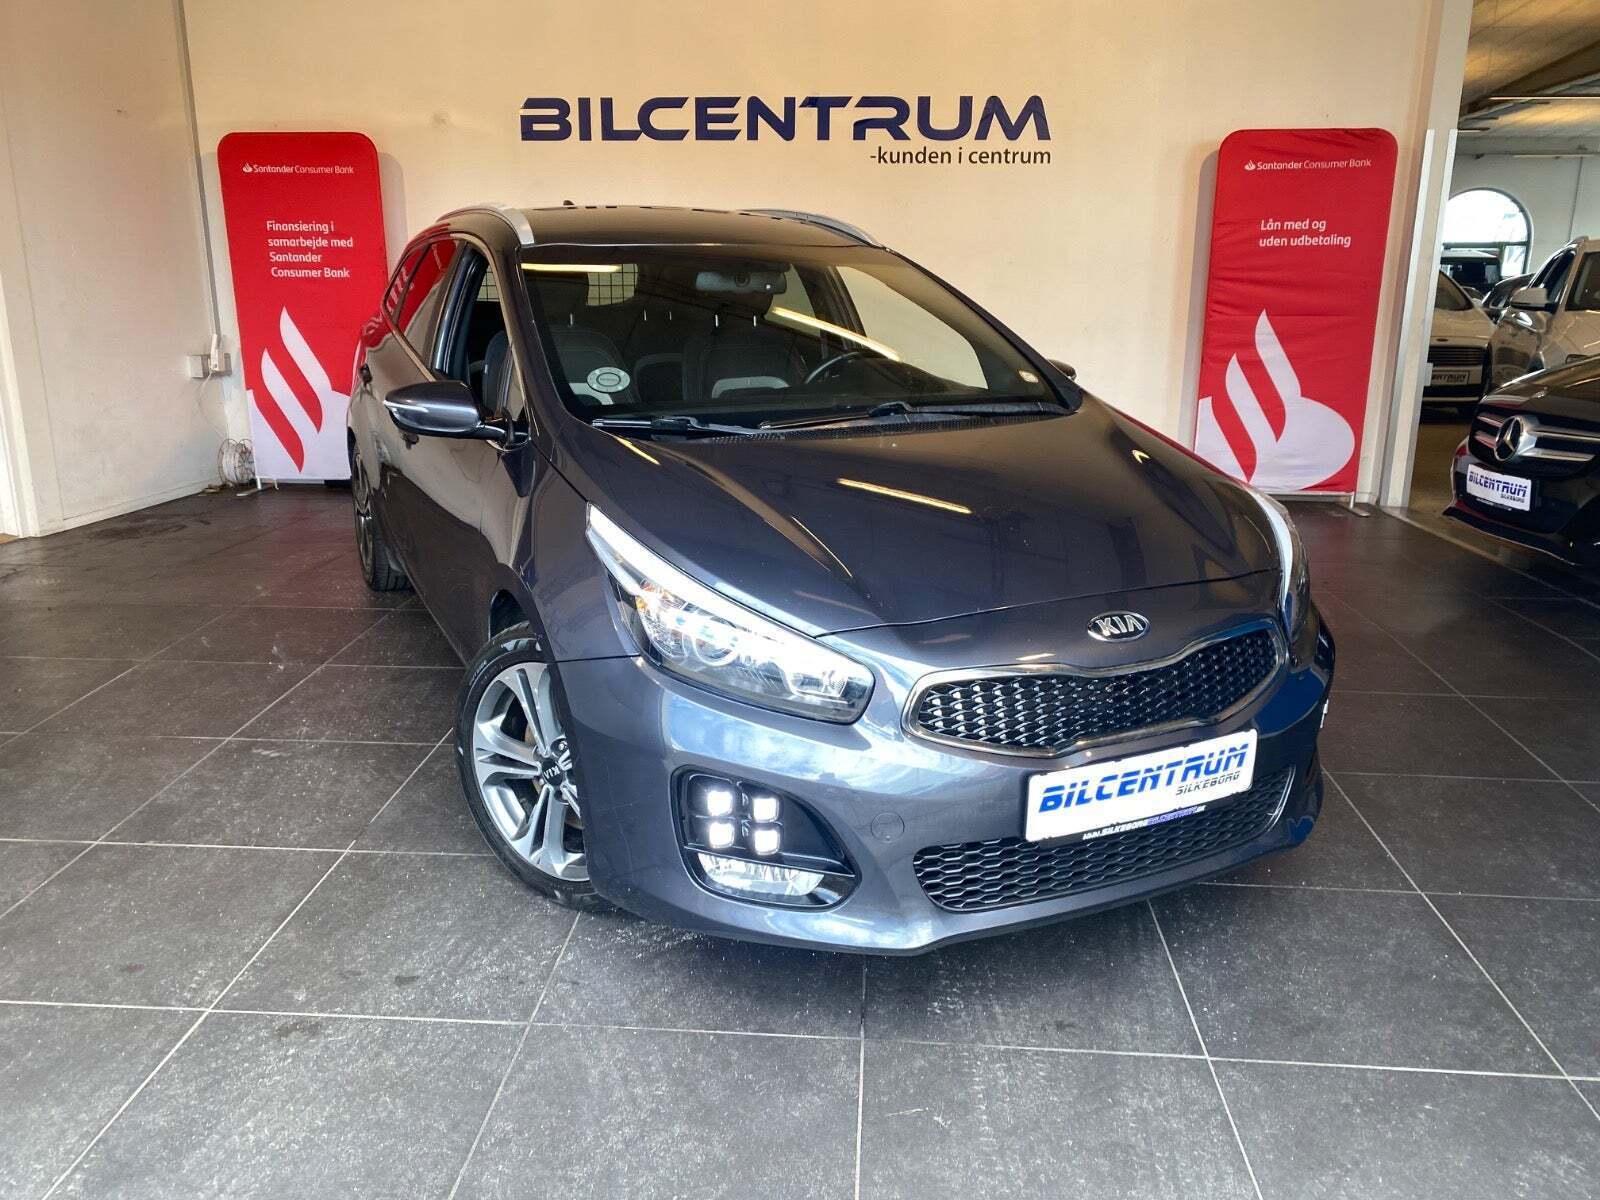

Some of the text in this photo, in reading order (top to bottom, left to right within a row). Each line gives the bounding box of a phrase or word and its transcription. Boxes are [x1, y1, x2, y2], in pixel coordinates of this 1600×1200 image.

[520, 95, 1051, 142] BILCENTRUM
[870, 147, 1052, 165] -kunden i centrum
[253, 164, 353, 174] Santander Consumer Bank
[1257, 159, 1371, 170] Santander Consumer Bank
[266, 220, 334, 234] Finansiering i
[1260, 218, 1327, 231] Lån med og
[268, 237, 353, 250] samarbejde med
[1259, 233, 1351, 248] uden udbetaling
[269, 251, 322, 262] Santander
[271, 267, 350, 278] Consumer Bank
[1468, 471, 1528, 498] BILCENTRUM
[1095, 615, 1144, 637] KIA
[543, 766, 560, 779] KIA
[1039, 743, 1249, 813] BILCENTRUM
[1176, 770, 1241, 796] SILKEBORG
